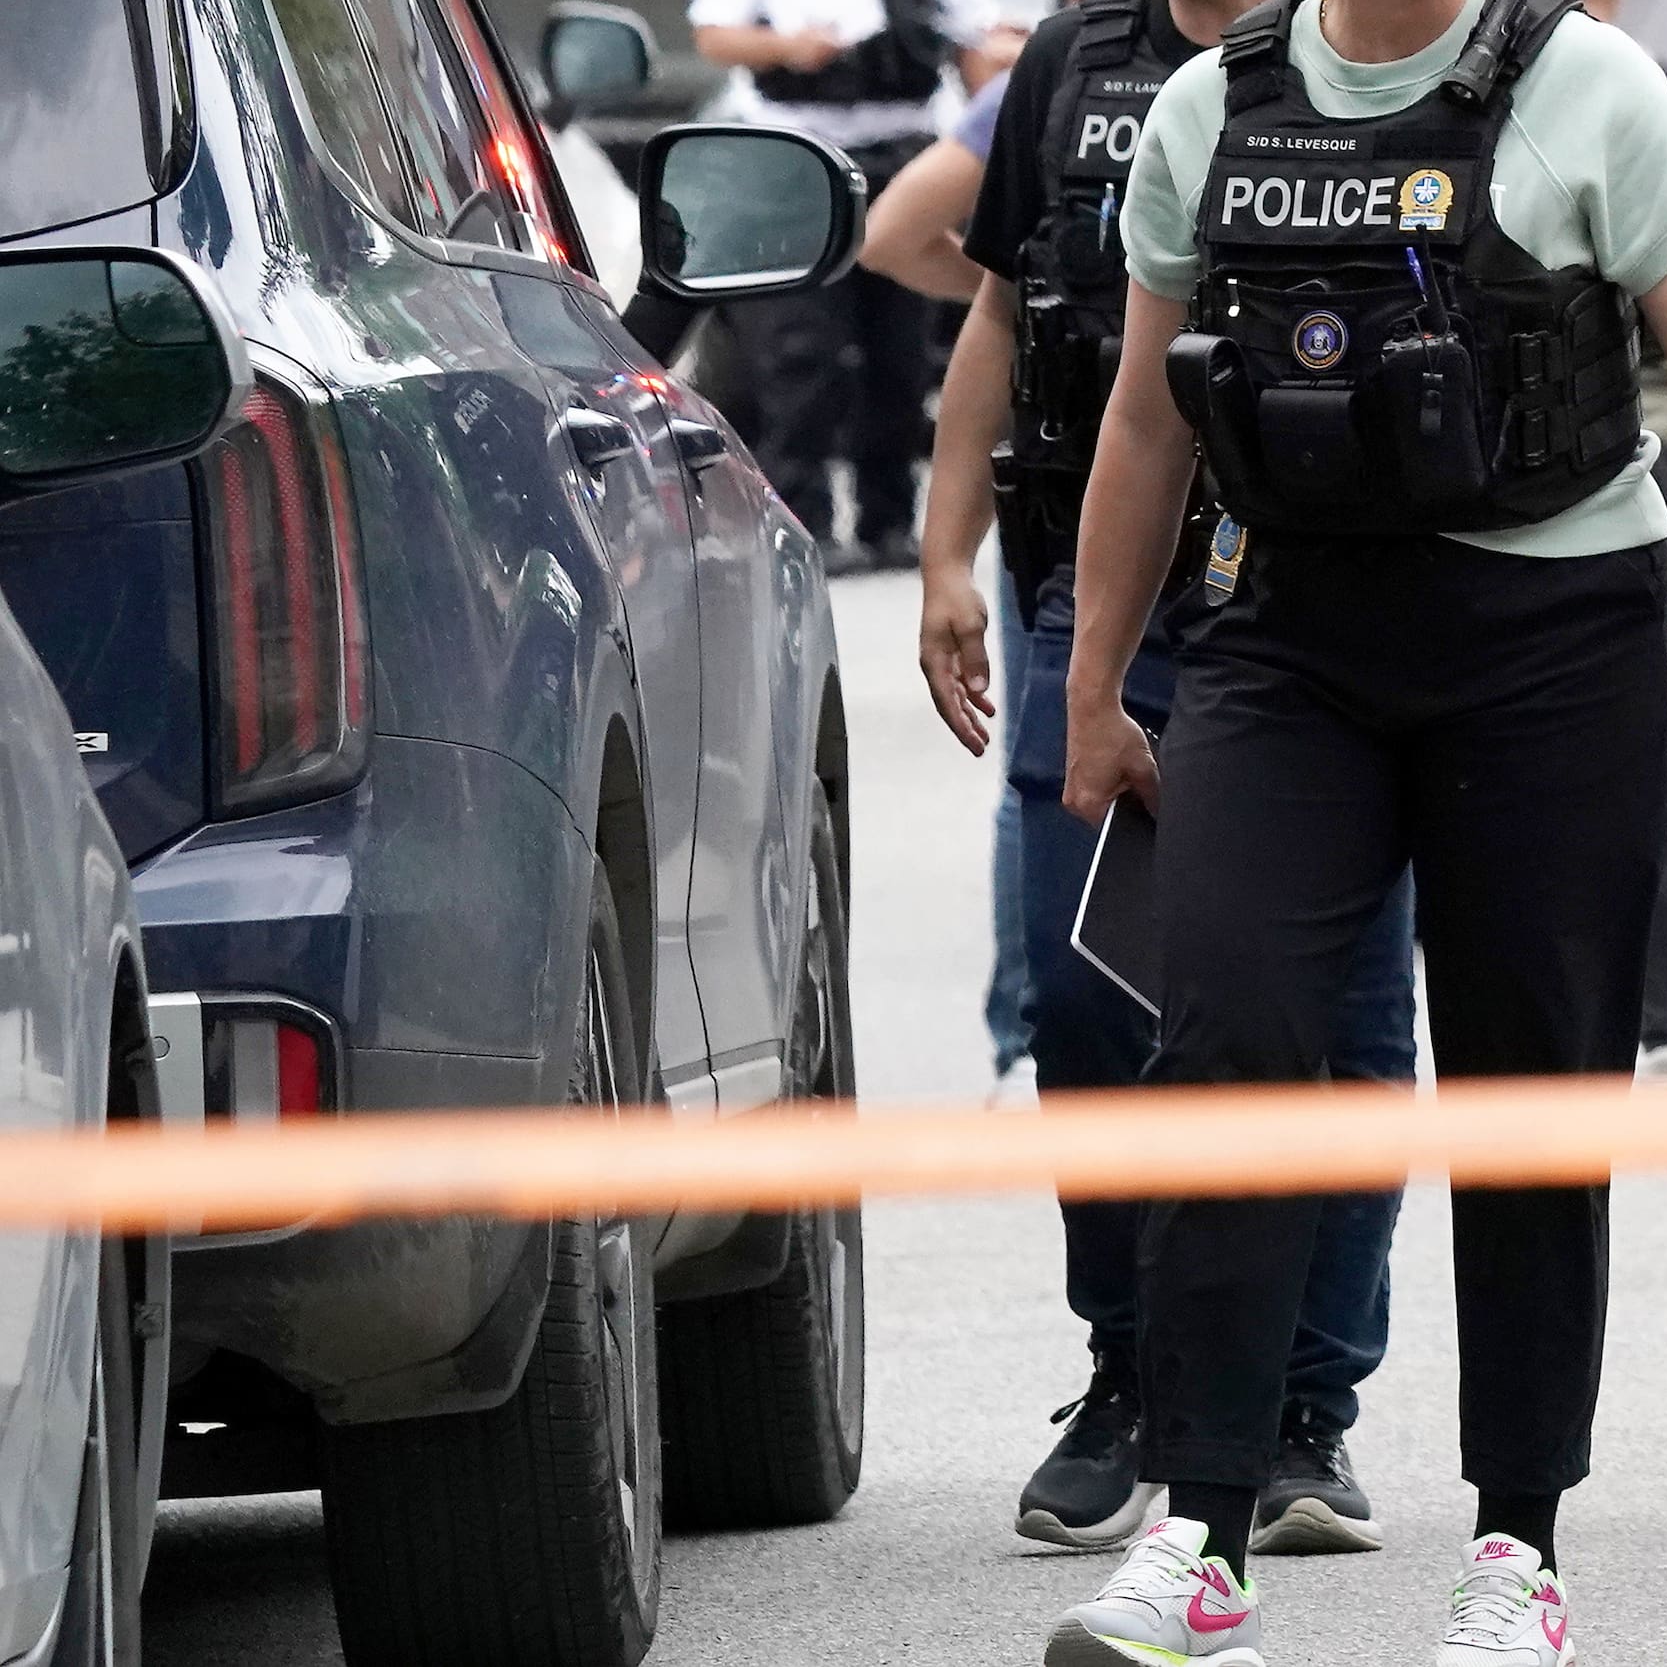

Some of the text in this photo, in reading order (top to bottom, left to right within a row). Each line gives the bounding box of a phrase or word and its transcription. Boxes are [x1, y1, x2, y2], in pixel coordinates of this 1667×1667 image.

[1247, 135, 1357, 151] S/D S. LEVESQUE
[1221, 176, 1396, 227] POLICE
[1481, 1541, 1514, 1556] NIKE
